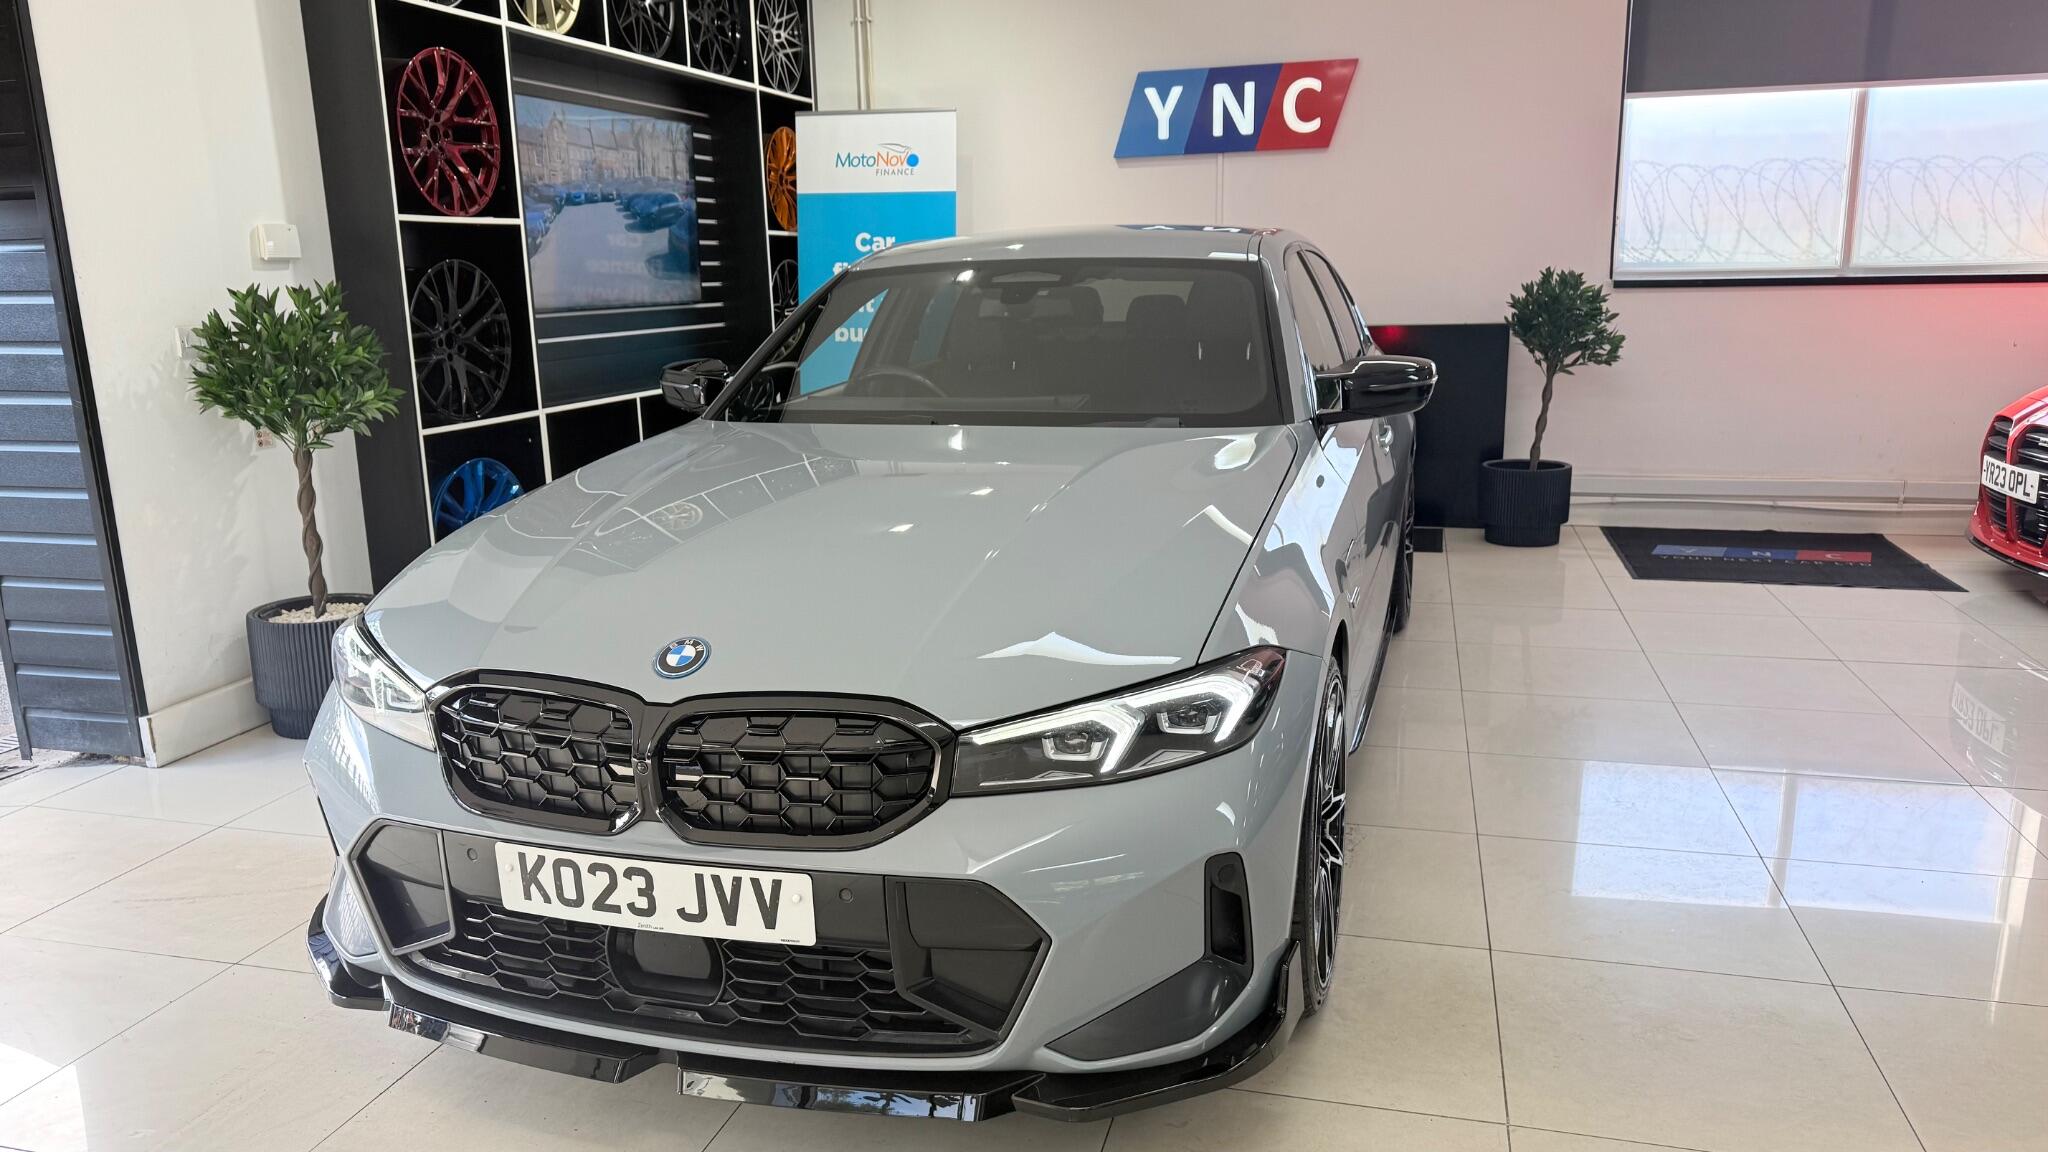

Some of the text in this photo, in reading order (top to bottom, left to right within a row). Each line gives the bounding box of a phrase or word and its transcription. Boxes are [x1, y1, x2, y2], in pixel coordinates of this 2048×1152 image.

[1144, 77, 1322, 140] YNC
[875, 168, 915, 176] FINANCE
[855, 232, 896, 253] Car
[1985, 460, 2031, 497] YR23 OPL
[517, 851, 783, 930] KO23 JVV
